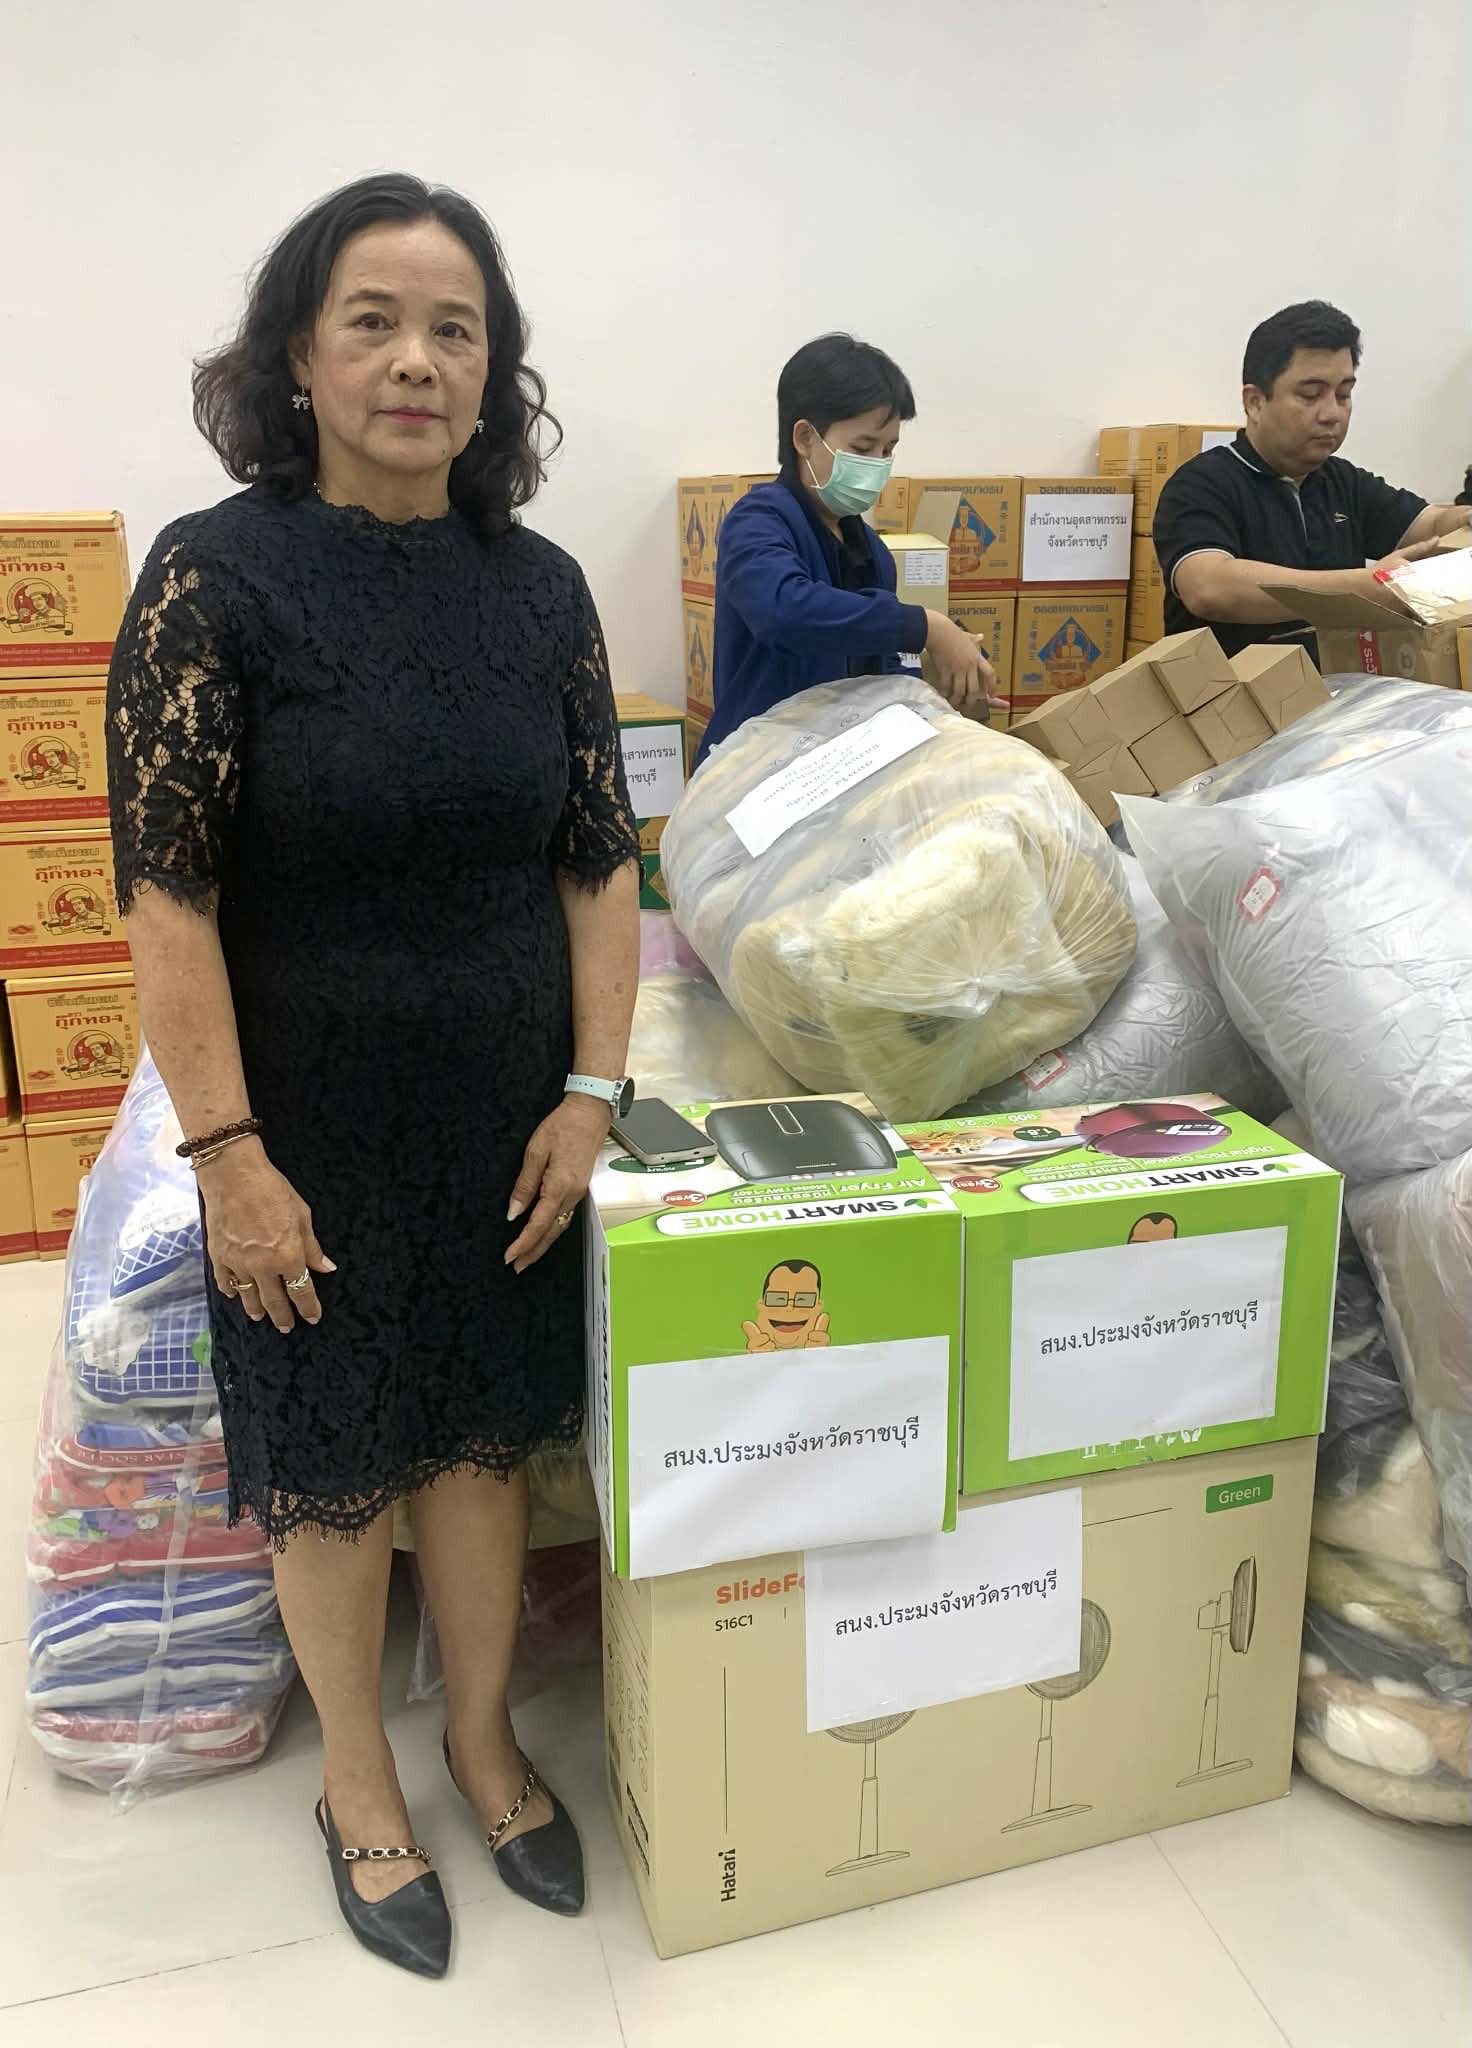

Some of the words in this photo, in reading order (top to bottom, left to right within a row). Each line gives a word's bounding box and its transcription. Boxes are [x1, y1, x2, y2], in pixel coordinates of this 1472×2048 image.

[837, 1181, 894, 1193] Fryer
[898, 1178, 926, 1190] Air
[1044, 1166, 1261, 1200] SMARTHOME
[682, 1199, 900, 1230] SMARTHOME
[1040, 1299, 1259, 1355] สนง.ประมงจังหวัดราชบุรี
[663, 1415, 920, 1469] สนง.ประมงจังหวัดราชบุรี
[1217, 1483, 1261, 1505] Green
[834, 1568, 1058, 1637] สนง.ประมงจังหวัดราชบุรี
[714, 1614, 754, 1632] S16C1
[720, 1848, 737, 1902] Hatari
